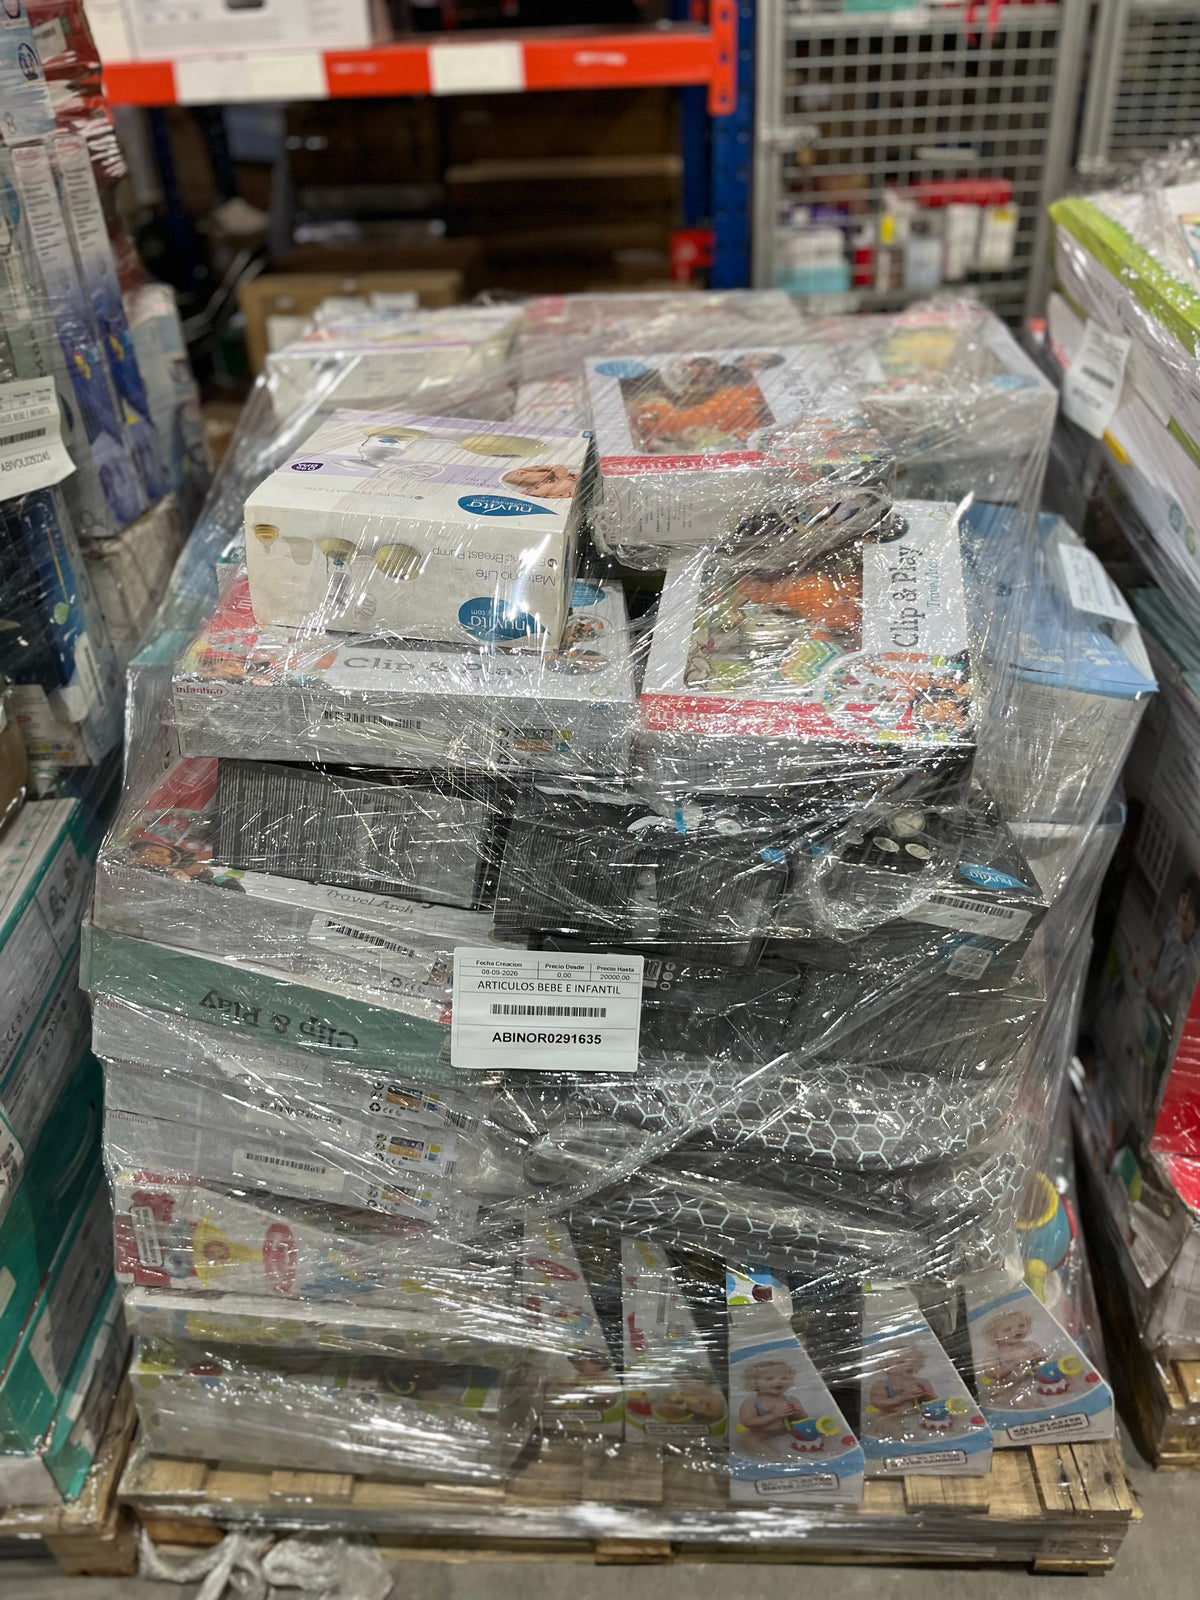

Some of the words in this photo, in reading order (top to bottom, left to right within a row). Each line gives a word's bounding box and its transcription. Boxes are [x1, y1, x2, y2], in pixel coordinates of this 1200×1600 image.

[470, 501, 533, 514] nuvita
[468, 551, 504, 564] Breast
[506, 554, 546, 568] Eric
[889, 545, 923, 584] Play
[475, 569, 498, 582] Life
[501, 572, 556, 587] Mateno
[892, 588, 917, 602] &
[470, 615, 526, 635] nuvita
[889, 607, 925, 648] Clip
[344, 657, 415, 674] Clip
[427, 662, 449, 673] &
[326, 888, 376, 906] Travel
[376, 900, 414, 914] Arch
[475, 959, 495, 967] Fecha
[496, 960, 523, 968] Creacion
[596, 965, 616, 973] Precio
[616, 966, 635, 974] Hasta
[481, 968, 519, 977] 08-09-2026
[477, 980, 535, 992] ARTICULOS
[537, 983, 563, 993] BEBE
[565, 983, 572, 993] E
[574, 984, 621, 995] INFANTIL
[199, 989, 262, 1028] Play
[271, 1015, 292, 1034] &
[299, 1016, 360, 1052] Clip
[491, 1032, 602, 1045] ABINOR0291635
